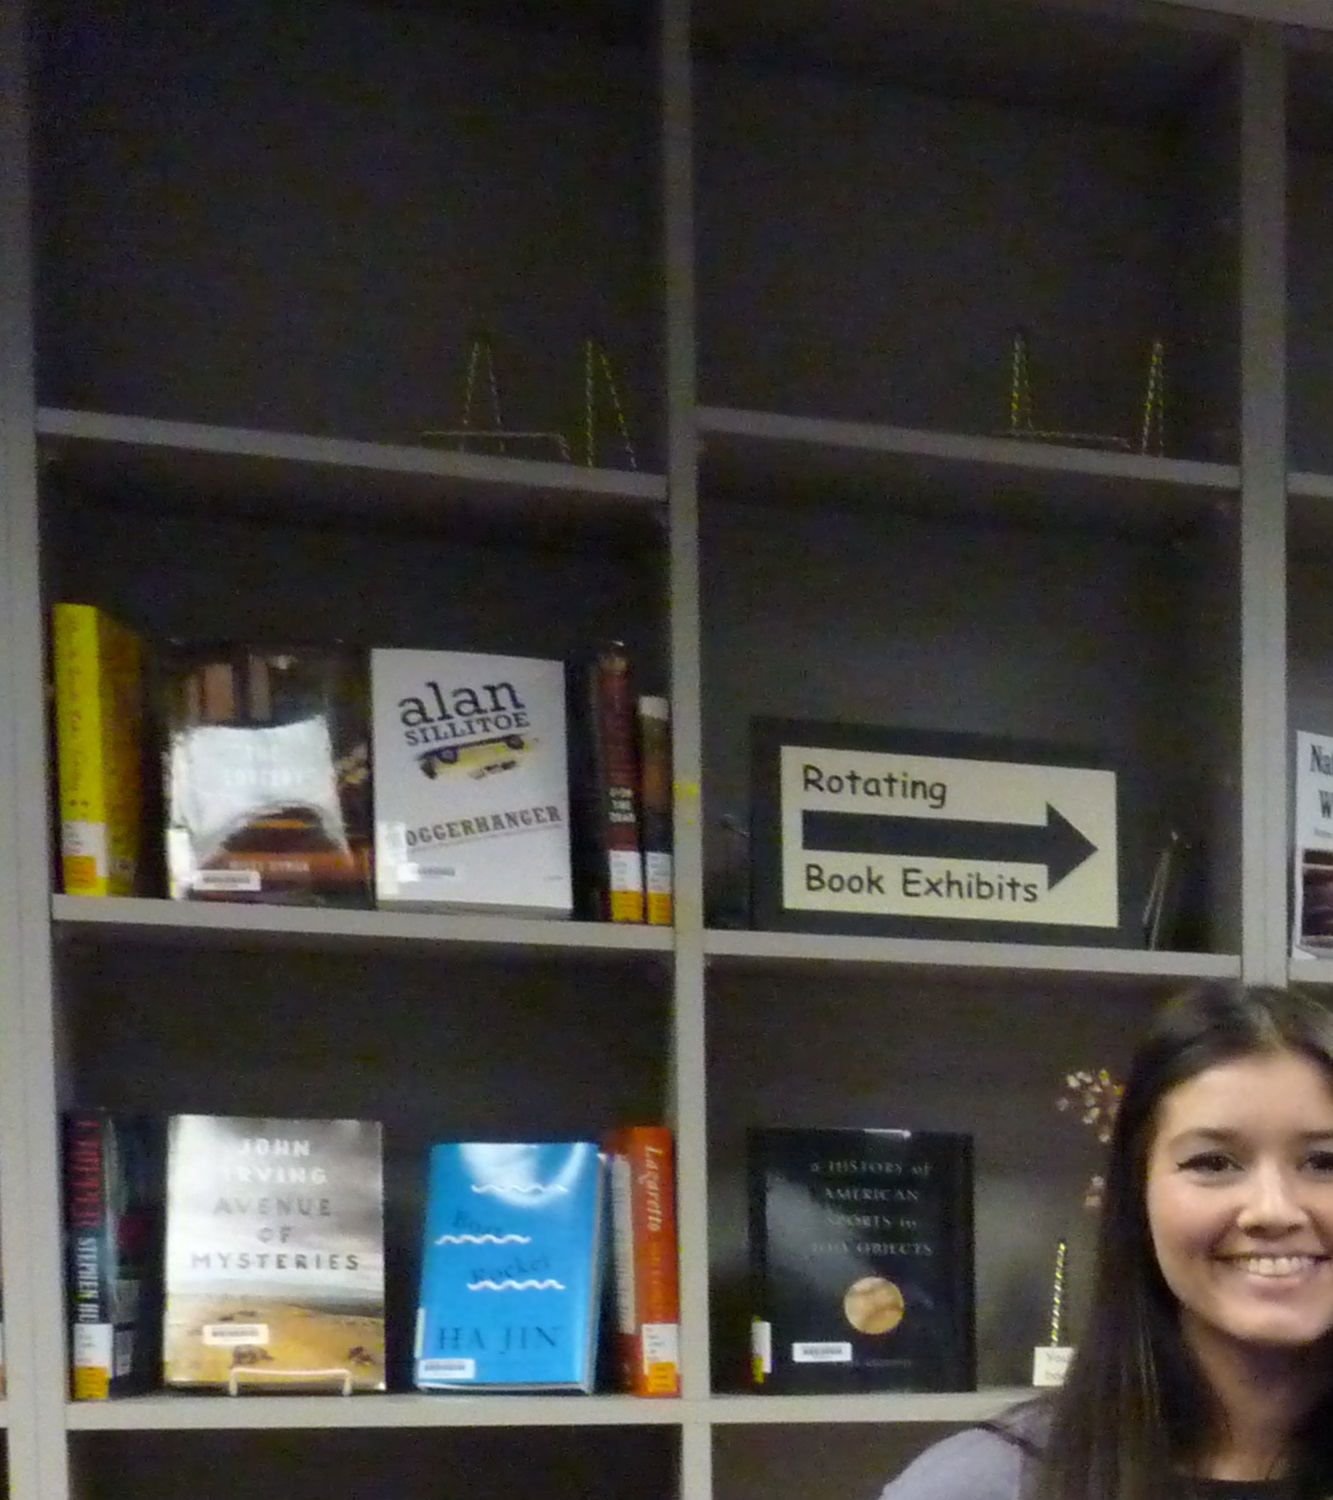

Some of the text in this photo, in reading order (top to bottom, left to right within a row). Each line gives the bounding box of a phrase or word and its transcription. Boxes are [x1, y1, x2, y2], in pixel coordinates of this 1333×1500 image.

[398, 680, 526, 728] alan
[404, 711, 531, 748] SILLITOE
[802, 764, 947, 809] Rotating
[405, 805, 563, 847] OGGERHANGER
[804, 863, 1039, 903] Book Exhibits
[239, 1138, 311, 1157] JOHN
[224, 1166, 328, 1185] IRVING
[827, 1160, 903, 1175] HISTORY
[825, 1187, 920, 1202] AMERICAN
[212, 1198, 331, 1217] AVENUE
[256, 1225, 293, 1244] OF
[191, 1253, 360, 1271] MYSTERIES
[436, 1324, 562, 1355] HA JIN
